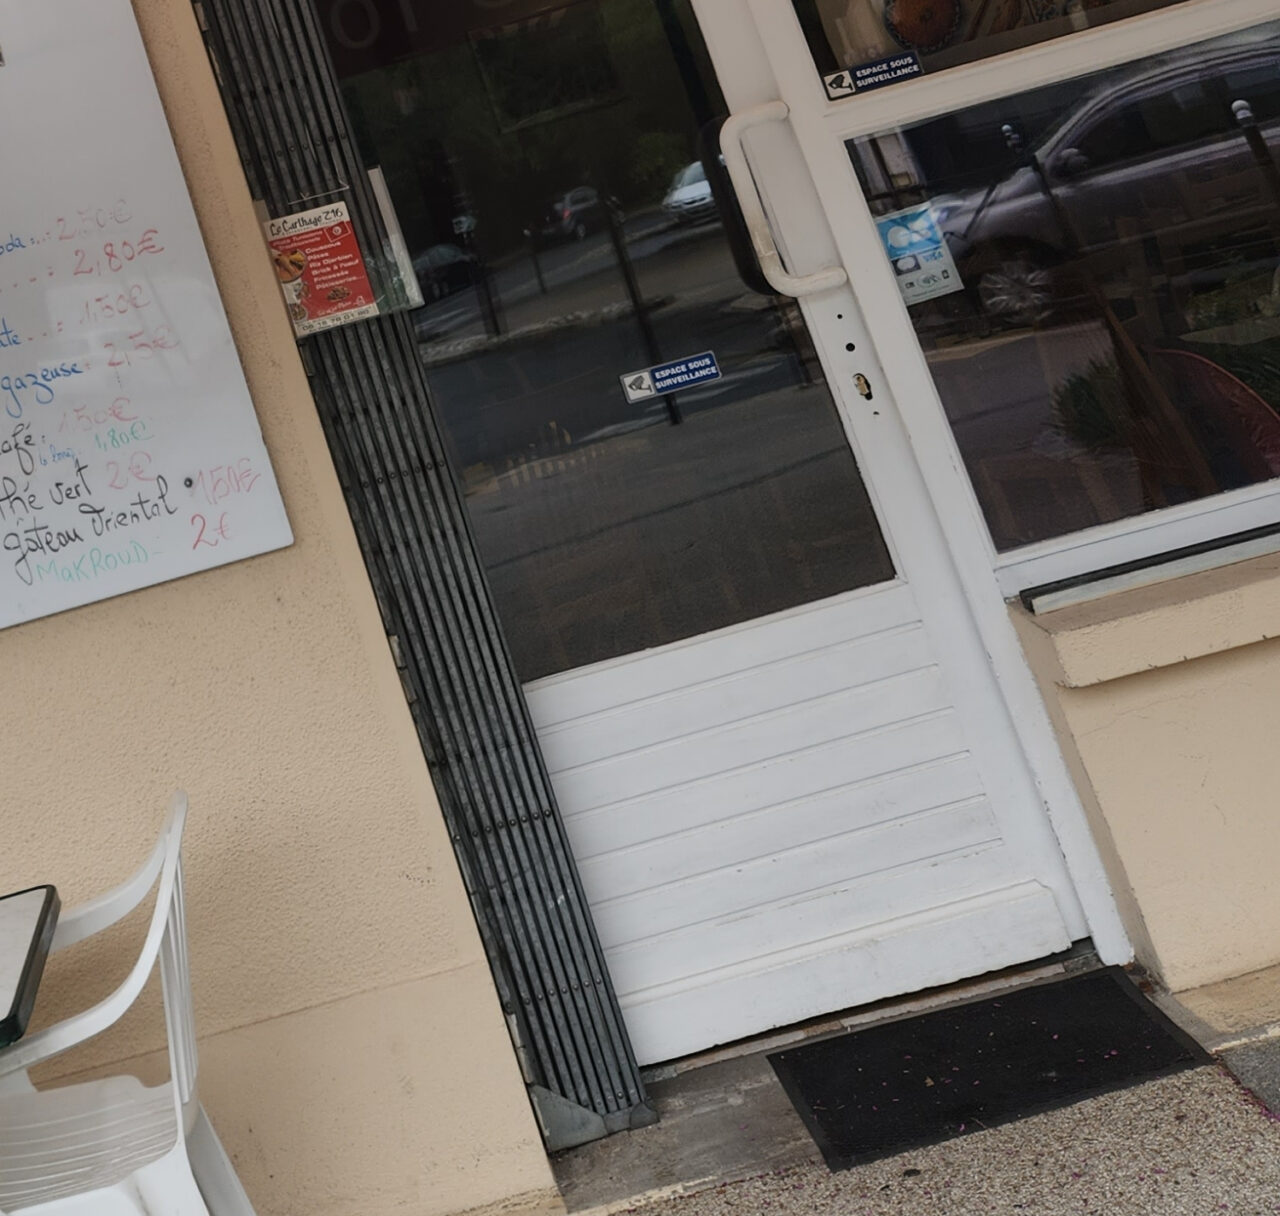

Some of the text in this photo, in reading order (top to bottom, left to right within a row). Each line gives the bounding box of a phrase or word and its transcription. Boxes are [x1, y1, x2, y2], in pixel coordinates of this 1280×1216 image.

[856, 56, 913, 77] ESPACE SOUS
[856, 64, 919, 87] SURVEILLANCE
[322, 208, 343, 221] 216
[655, 358, 711, 379] ESPACE SOUS
[655, 366, 717, 389] SURVEILLANCE
